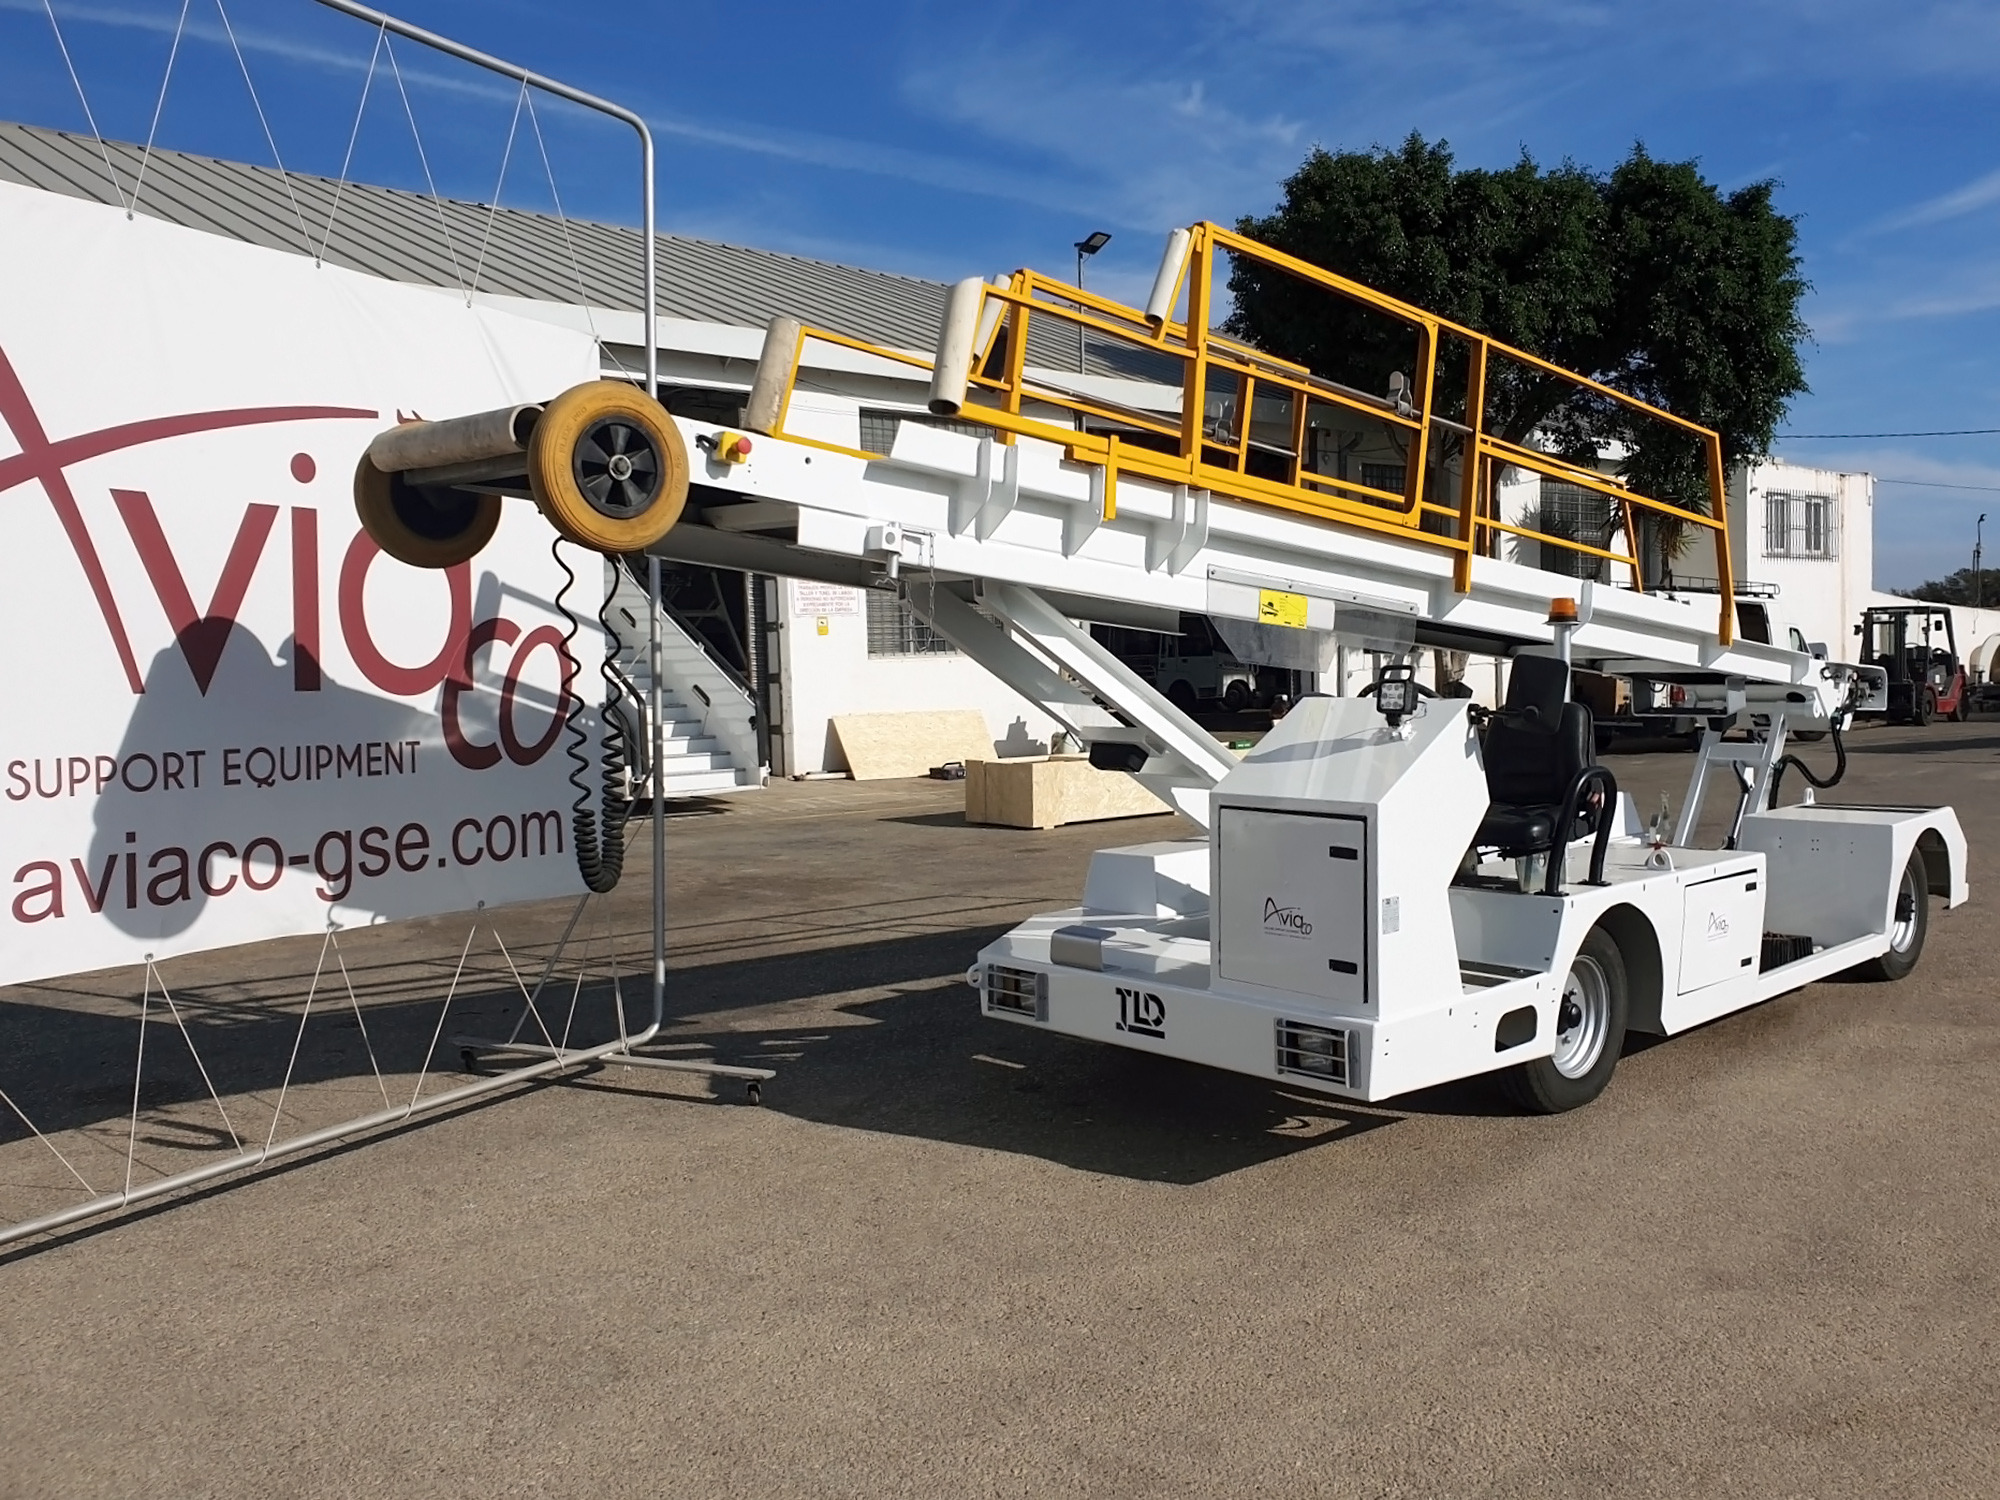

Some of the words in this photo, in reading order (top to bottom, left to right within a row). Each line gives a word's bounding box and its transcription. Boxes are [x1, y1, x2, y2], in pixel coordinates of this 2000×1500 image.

[5, 750, 206, 801] SUPPORT
[222, 740, 421, 789] EQUIPMENT
[11, 809, 564, 923] aviaco-gse.com
[1115, 987, 1165, 1034] TLD
